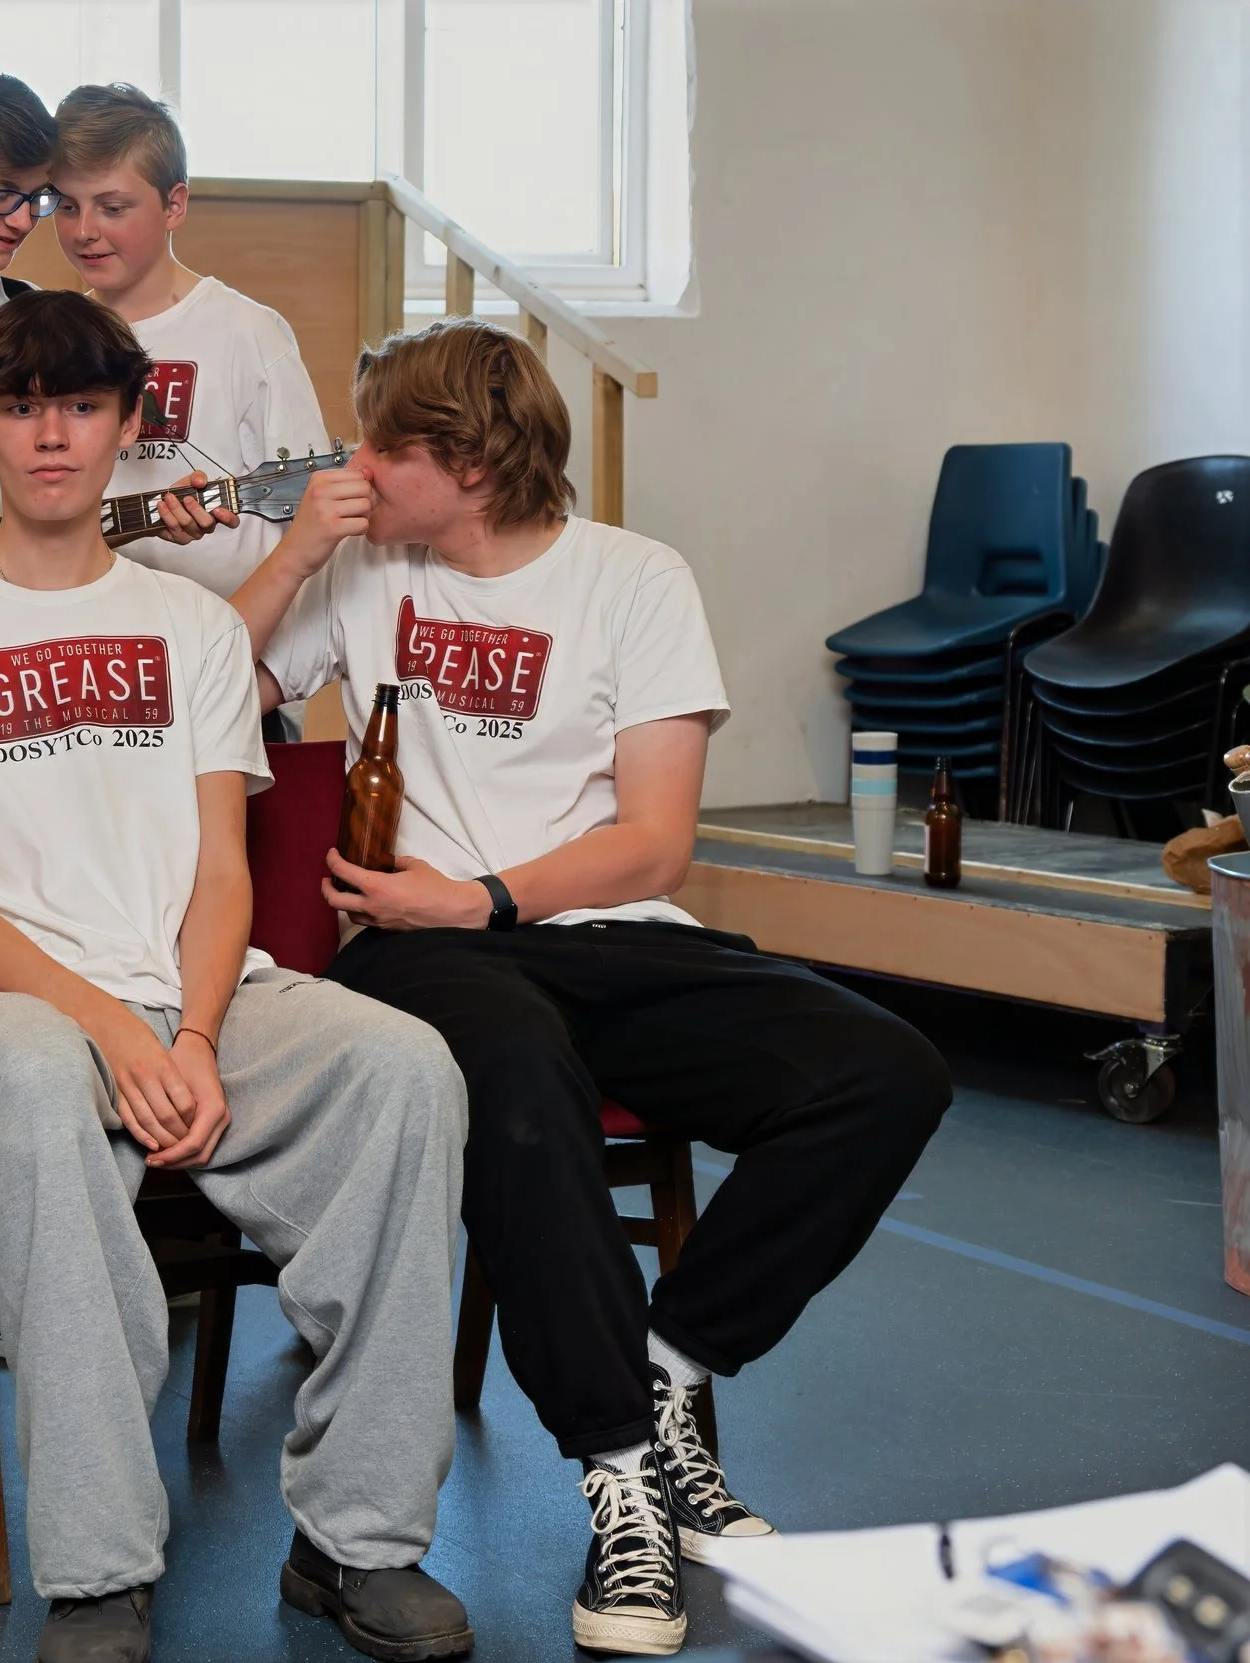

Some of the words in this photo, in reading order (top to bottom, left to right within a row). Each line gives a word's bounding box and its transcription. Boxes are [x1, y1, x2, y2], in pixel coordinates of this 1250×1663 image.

[137, 443, 177, 460] 2025
[419, 626, 436, 639] WE
[440, 629, 455, 641] GO
[461, 630, 509, 645] TOGETHER
[11, 652, 30, 667] WE
[36, 647, 52, 662] GO
[58, 643, 123, 657] TOGETHER
[407, 660, 417, 672] 19
[436, 690, 495, 710] MUSICAL
[510, 699, 525, 712] 59
[0, 722, 13, 735] 19
[23, 715, 53, 732] THE
[62, 707, 129, 721] MUSICAL
[145, 708, 159, 720] 59
[476, 718, 524, 740] 2025
[112, 729, 165, 748] 2025
